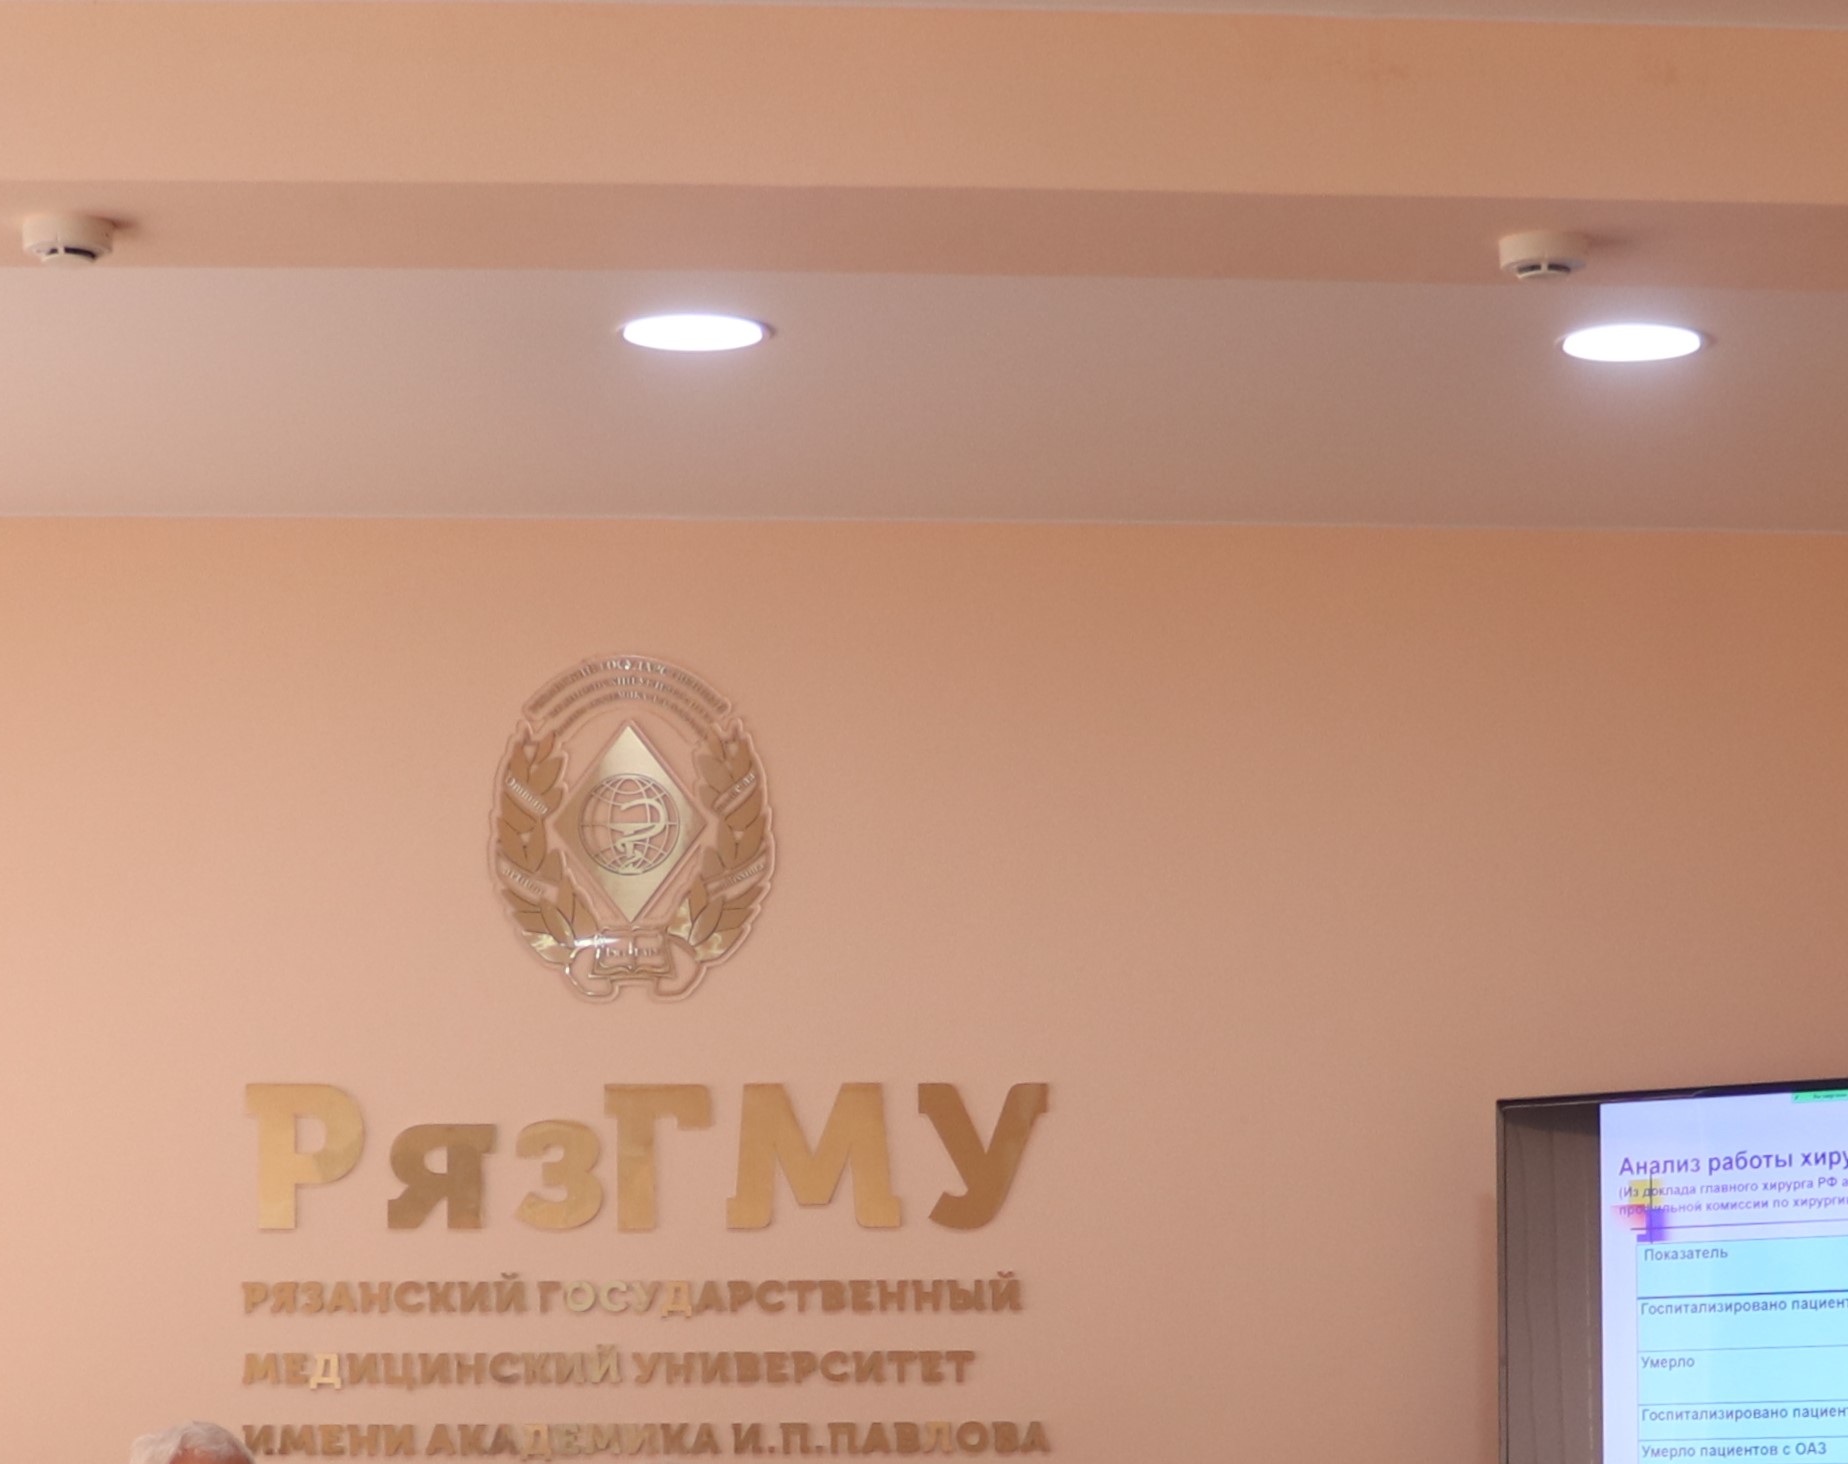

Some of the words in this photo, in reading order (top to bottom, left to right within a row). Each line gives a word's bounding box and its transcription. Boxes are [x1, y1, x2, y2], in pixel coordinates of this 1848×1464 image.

[244, 1081, 1050, 1232] РязГМУ
[1619, 1156, 1700, 1176] Анализ
[1707, 1150, 1793, 1175] работы
[1619, 1186, 1639, 1199] (Из
[1643, 1184, 1696, 1198] доклада
[1700, 1181, 1758, 1195] главного
[1763, 1179, 1814, 1195] хирурга
[1818, 1176, 1837, 1189] РФ
[1706, 1199, 1769, 1211] комиссии
[1772, 1198, 1789, 1209] по
[1644, 1247, 1728, 1262] Показатель
[241, 1273, 527, 1314] РЯЗАНСКИЙ
[537, 1272, 1023, 1319] ГОСУДАРСТВЕННЫЙ
[1641, 1300, 1787, 1316] Госпитализировано
[241, 1345, 622, 1392] МЕДИЦИНСКИЙ
[632, 1350, 976, 1385] УНИВЕРСИТЕТ
[1641, 1356, 1695, 1371] Умерло
[1642, 1407, 1788, 1422] Госпитализировано
[241, 1422, 416, 1459] ИМЕНИ
[427, 1421, 723, 1462] АКАДЕМИКА
[732, 1422, 1052, 1457] И.П.ПАВЛОВА
[1641, 1445, 1696, 1460] Умерло
[1700, 1444, 1778, 1458] пациентов
[1782, 1445, 1790, 1455] с
[1795, 1442, 1827, 1455] ОАЗ
